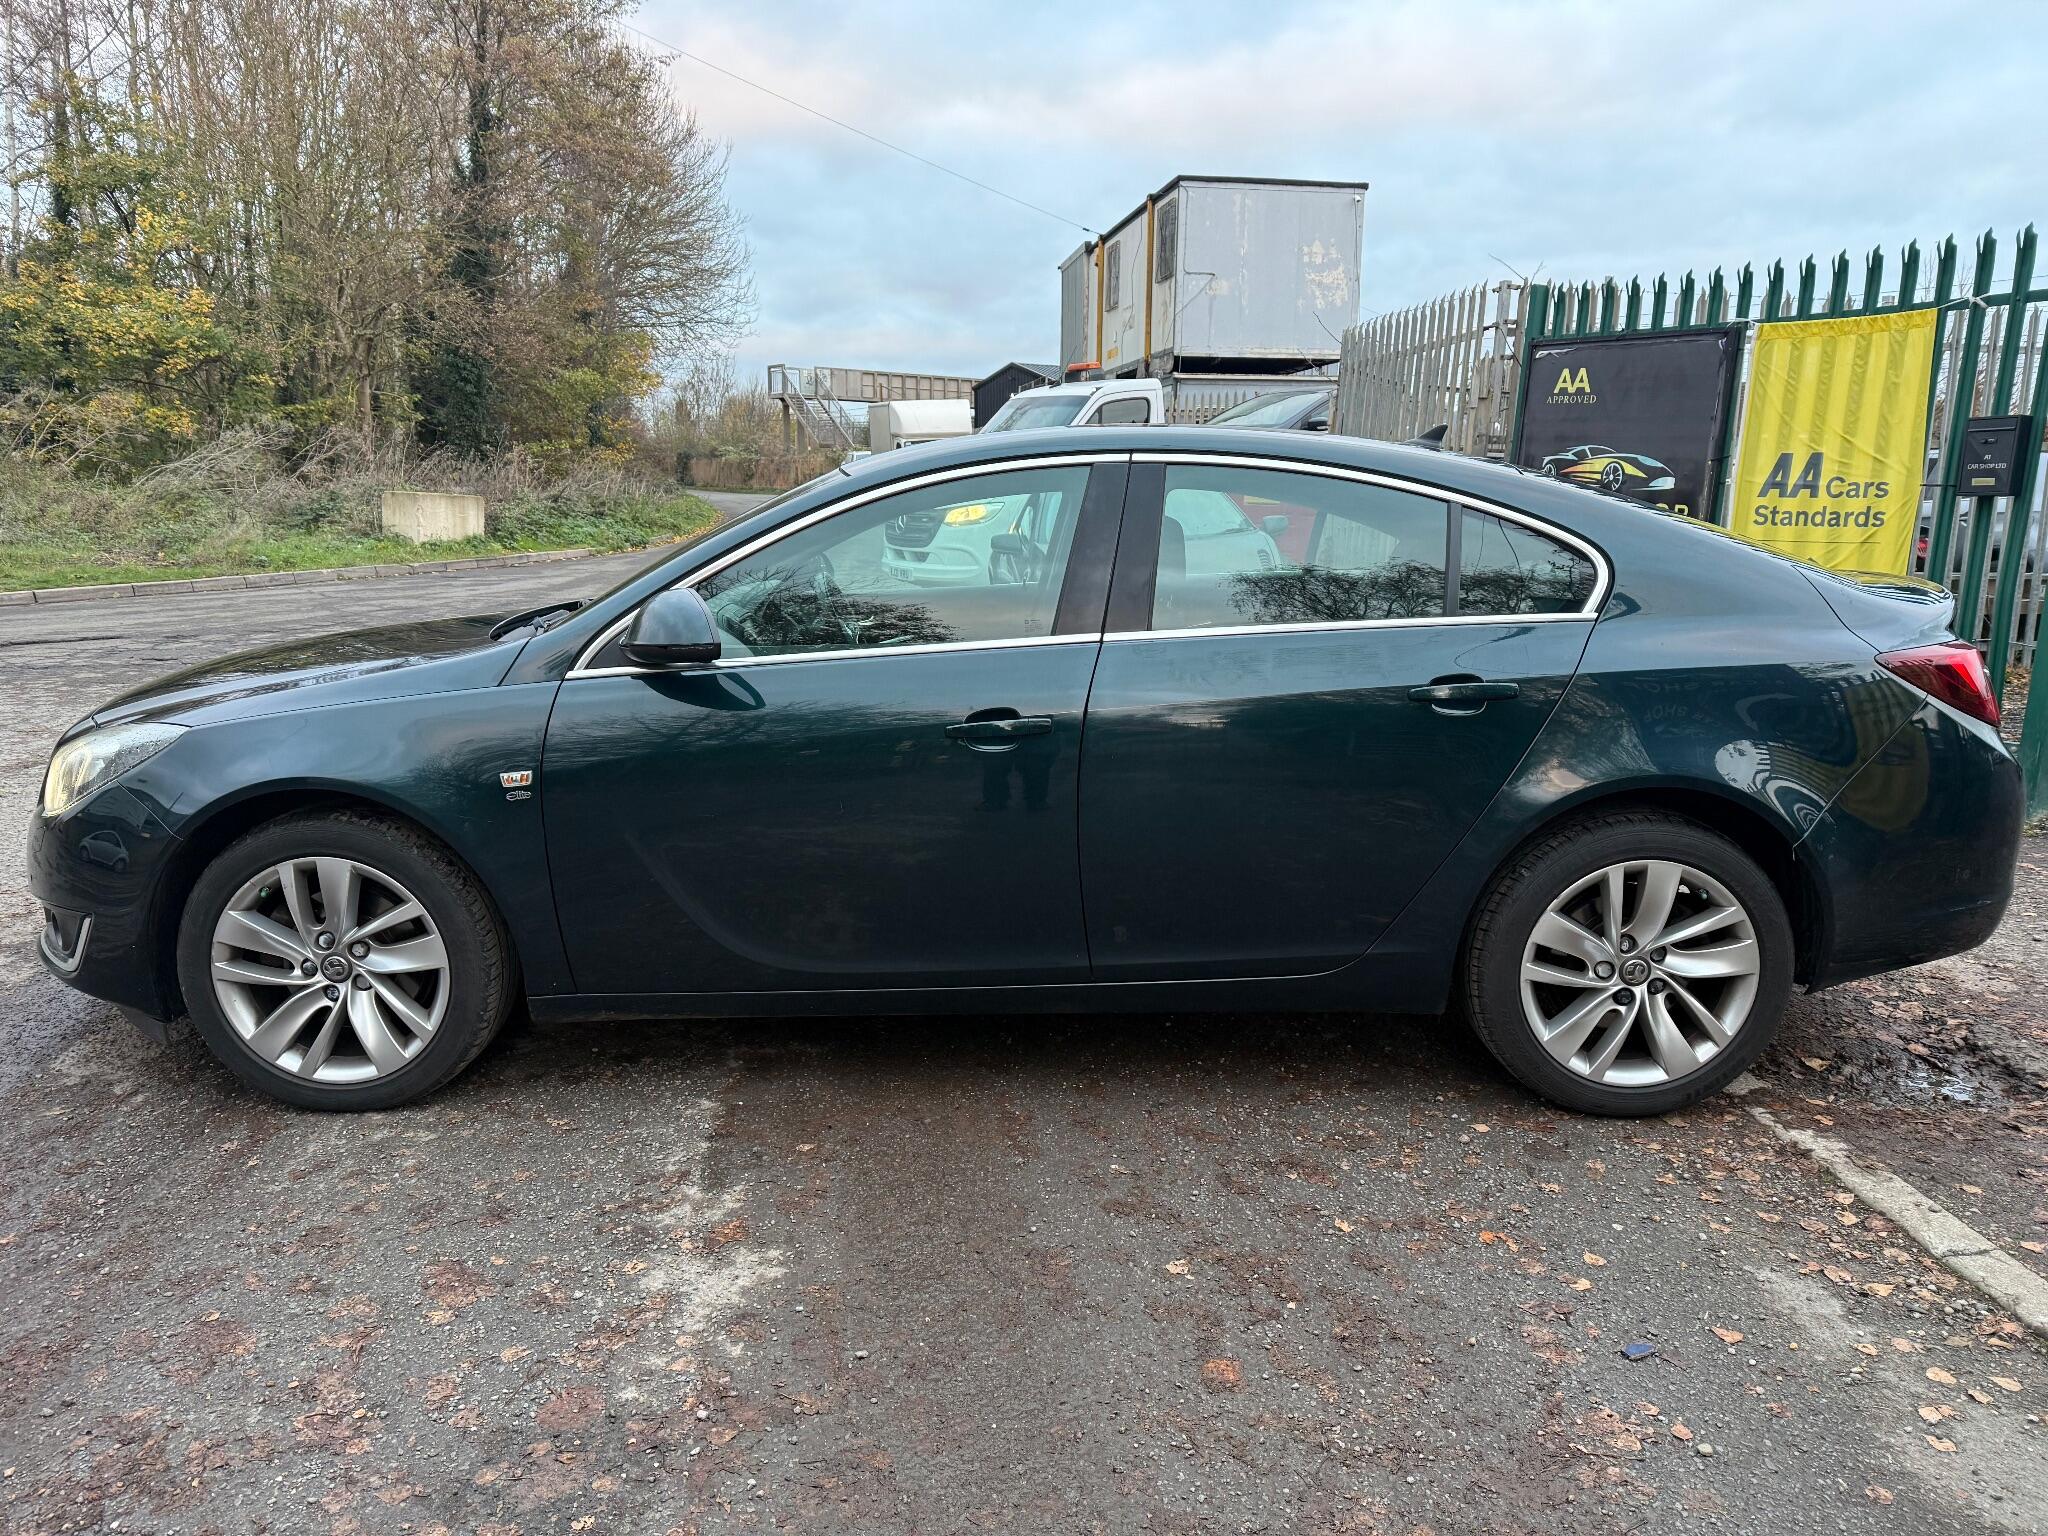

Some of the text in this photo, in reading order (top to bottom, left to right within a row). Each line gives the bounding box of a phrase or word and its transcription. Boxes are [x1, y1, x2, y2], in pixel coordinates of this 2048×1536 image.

[1553, 367, 1591, 393] AA
[1546, 394, 1597, 404] APPROVED
[1757, 452, 1890, 499] AA Cars
[1752, 505, 1887, 528] Standards
